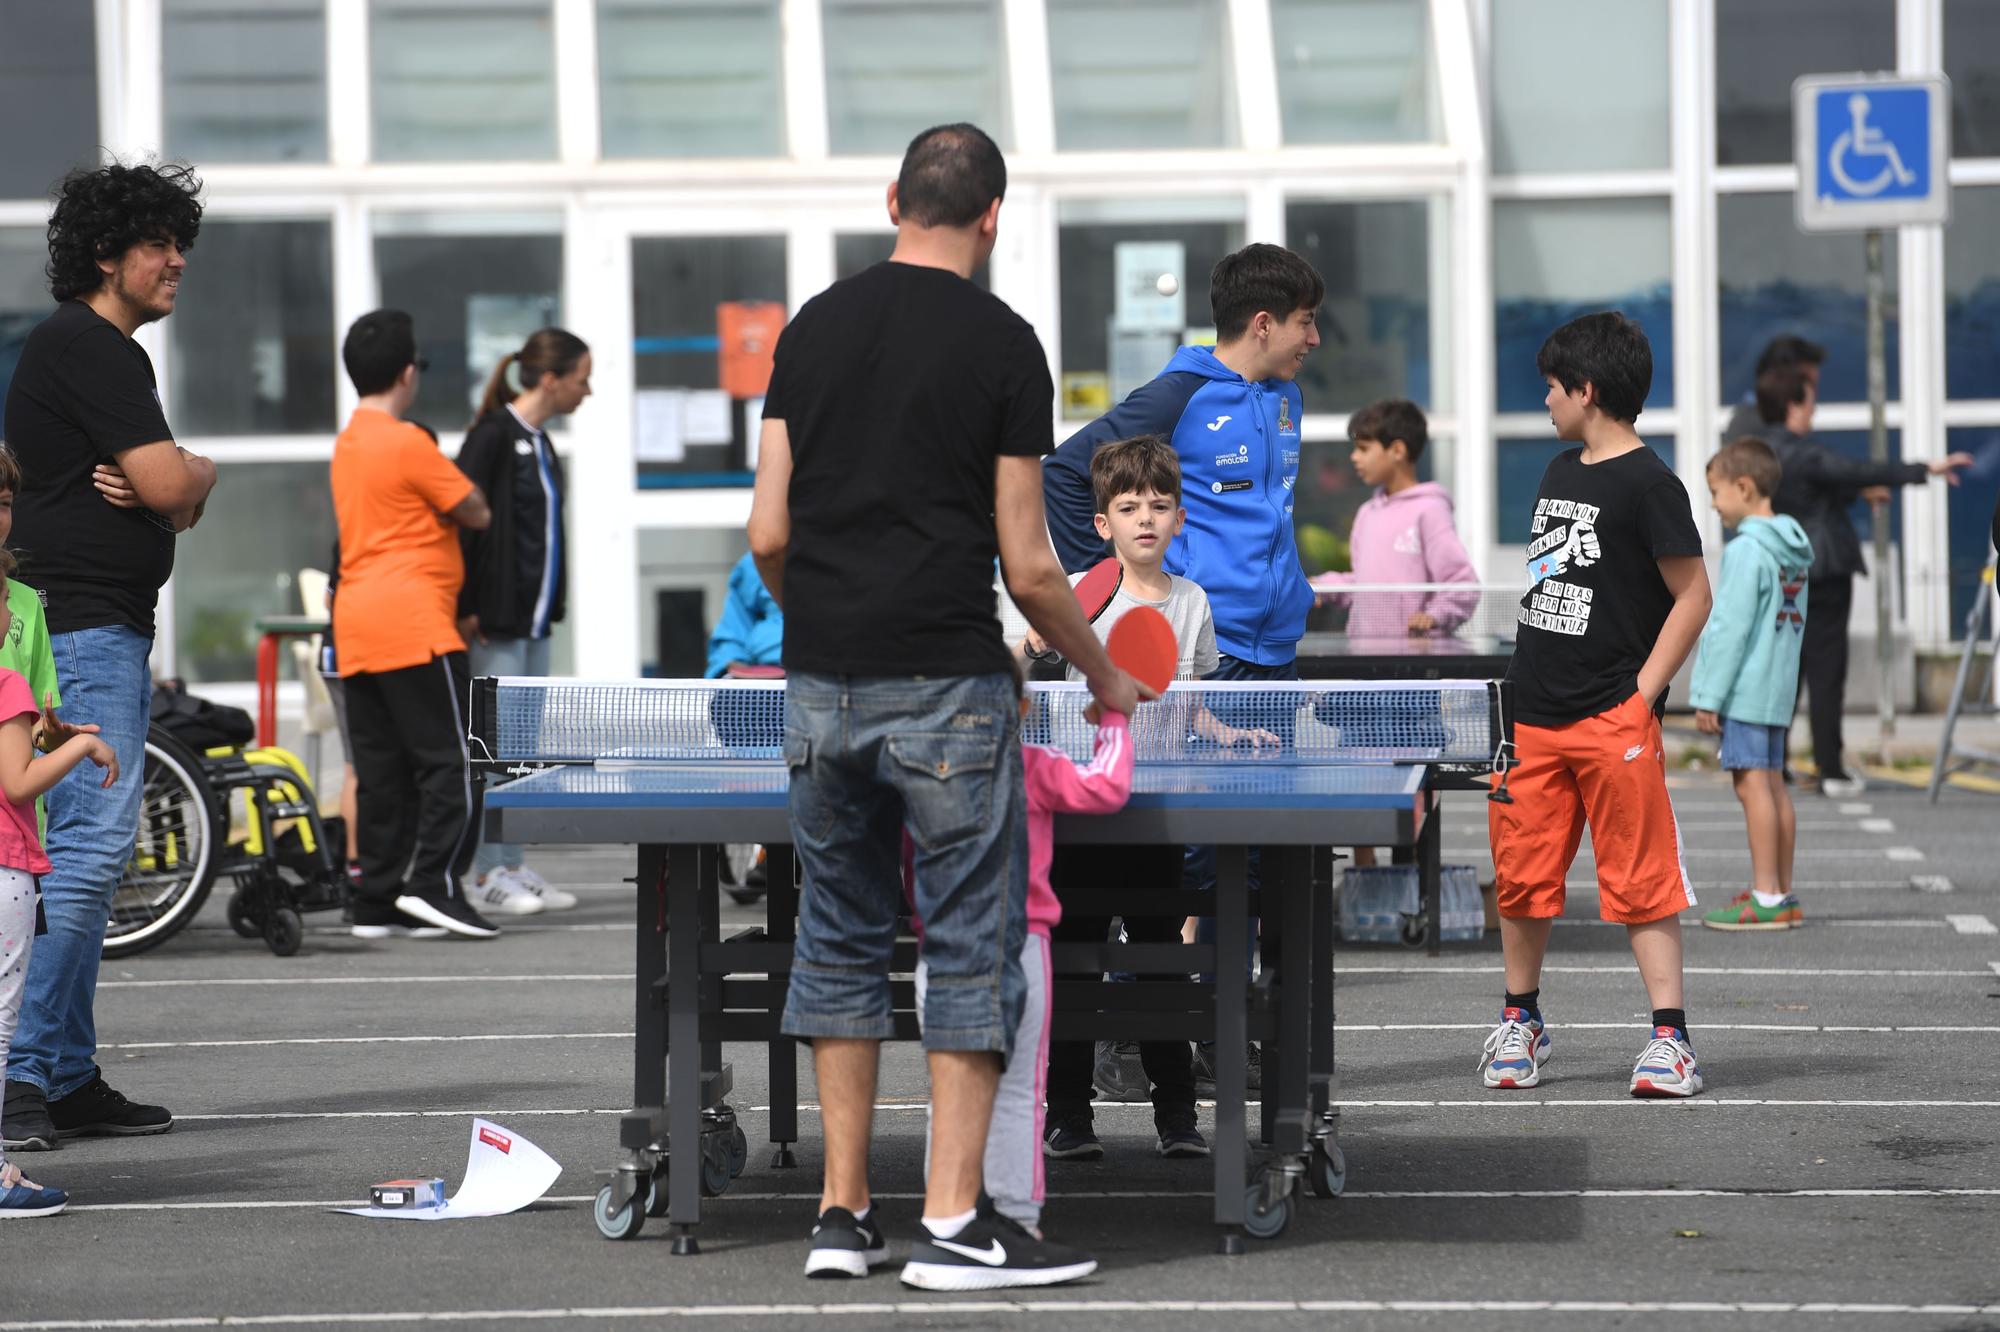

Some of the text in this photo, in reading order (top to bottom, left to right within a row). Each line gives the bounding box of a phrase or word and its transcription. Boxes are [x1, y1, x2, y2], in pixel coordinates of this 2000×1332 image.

[1546, 500, 1575, 517] ANOS
[1573, 504, 1598, 522] NON
[1533, 517, 1547, 531] ON
[1543, 580, 1592, 601] POR ELAS
[1538, 596, 1558, 612] POR
